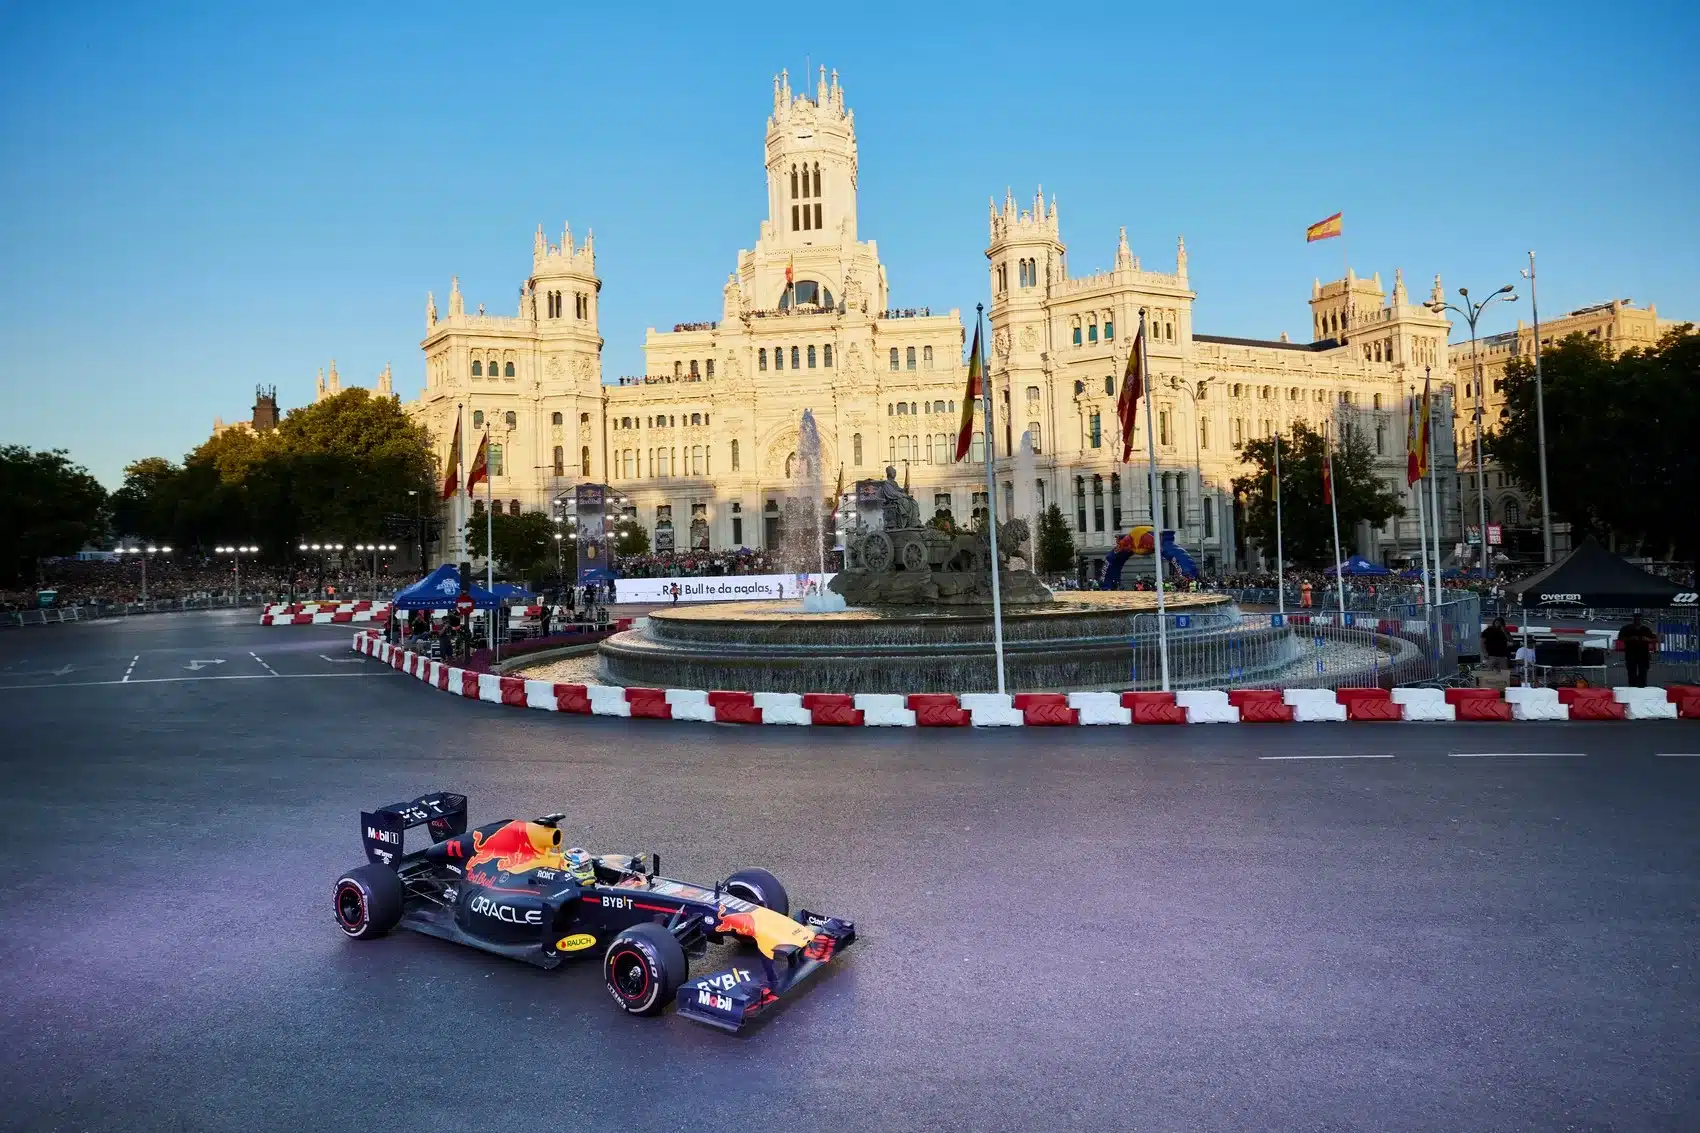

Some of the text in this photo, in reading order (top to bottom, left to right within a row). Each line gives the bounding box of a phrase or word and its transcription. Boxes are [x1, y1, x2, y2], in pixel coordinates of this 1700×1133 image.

[685, 583, 704, 594] Bull
[706, 585, 716, 594] te
[718, 582, 732, 594] da
[367, 826, 390, 843] Mobil
[471, 896, 544, 925] ORACLE
[602, 895, 633, 909] BYBIT
[566, 937, 592, 947] RAUCH
[633, 941, 658, 978] ZERO
[698, 990, 732, 1011] Mobil
